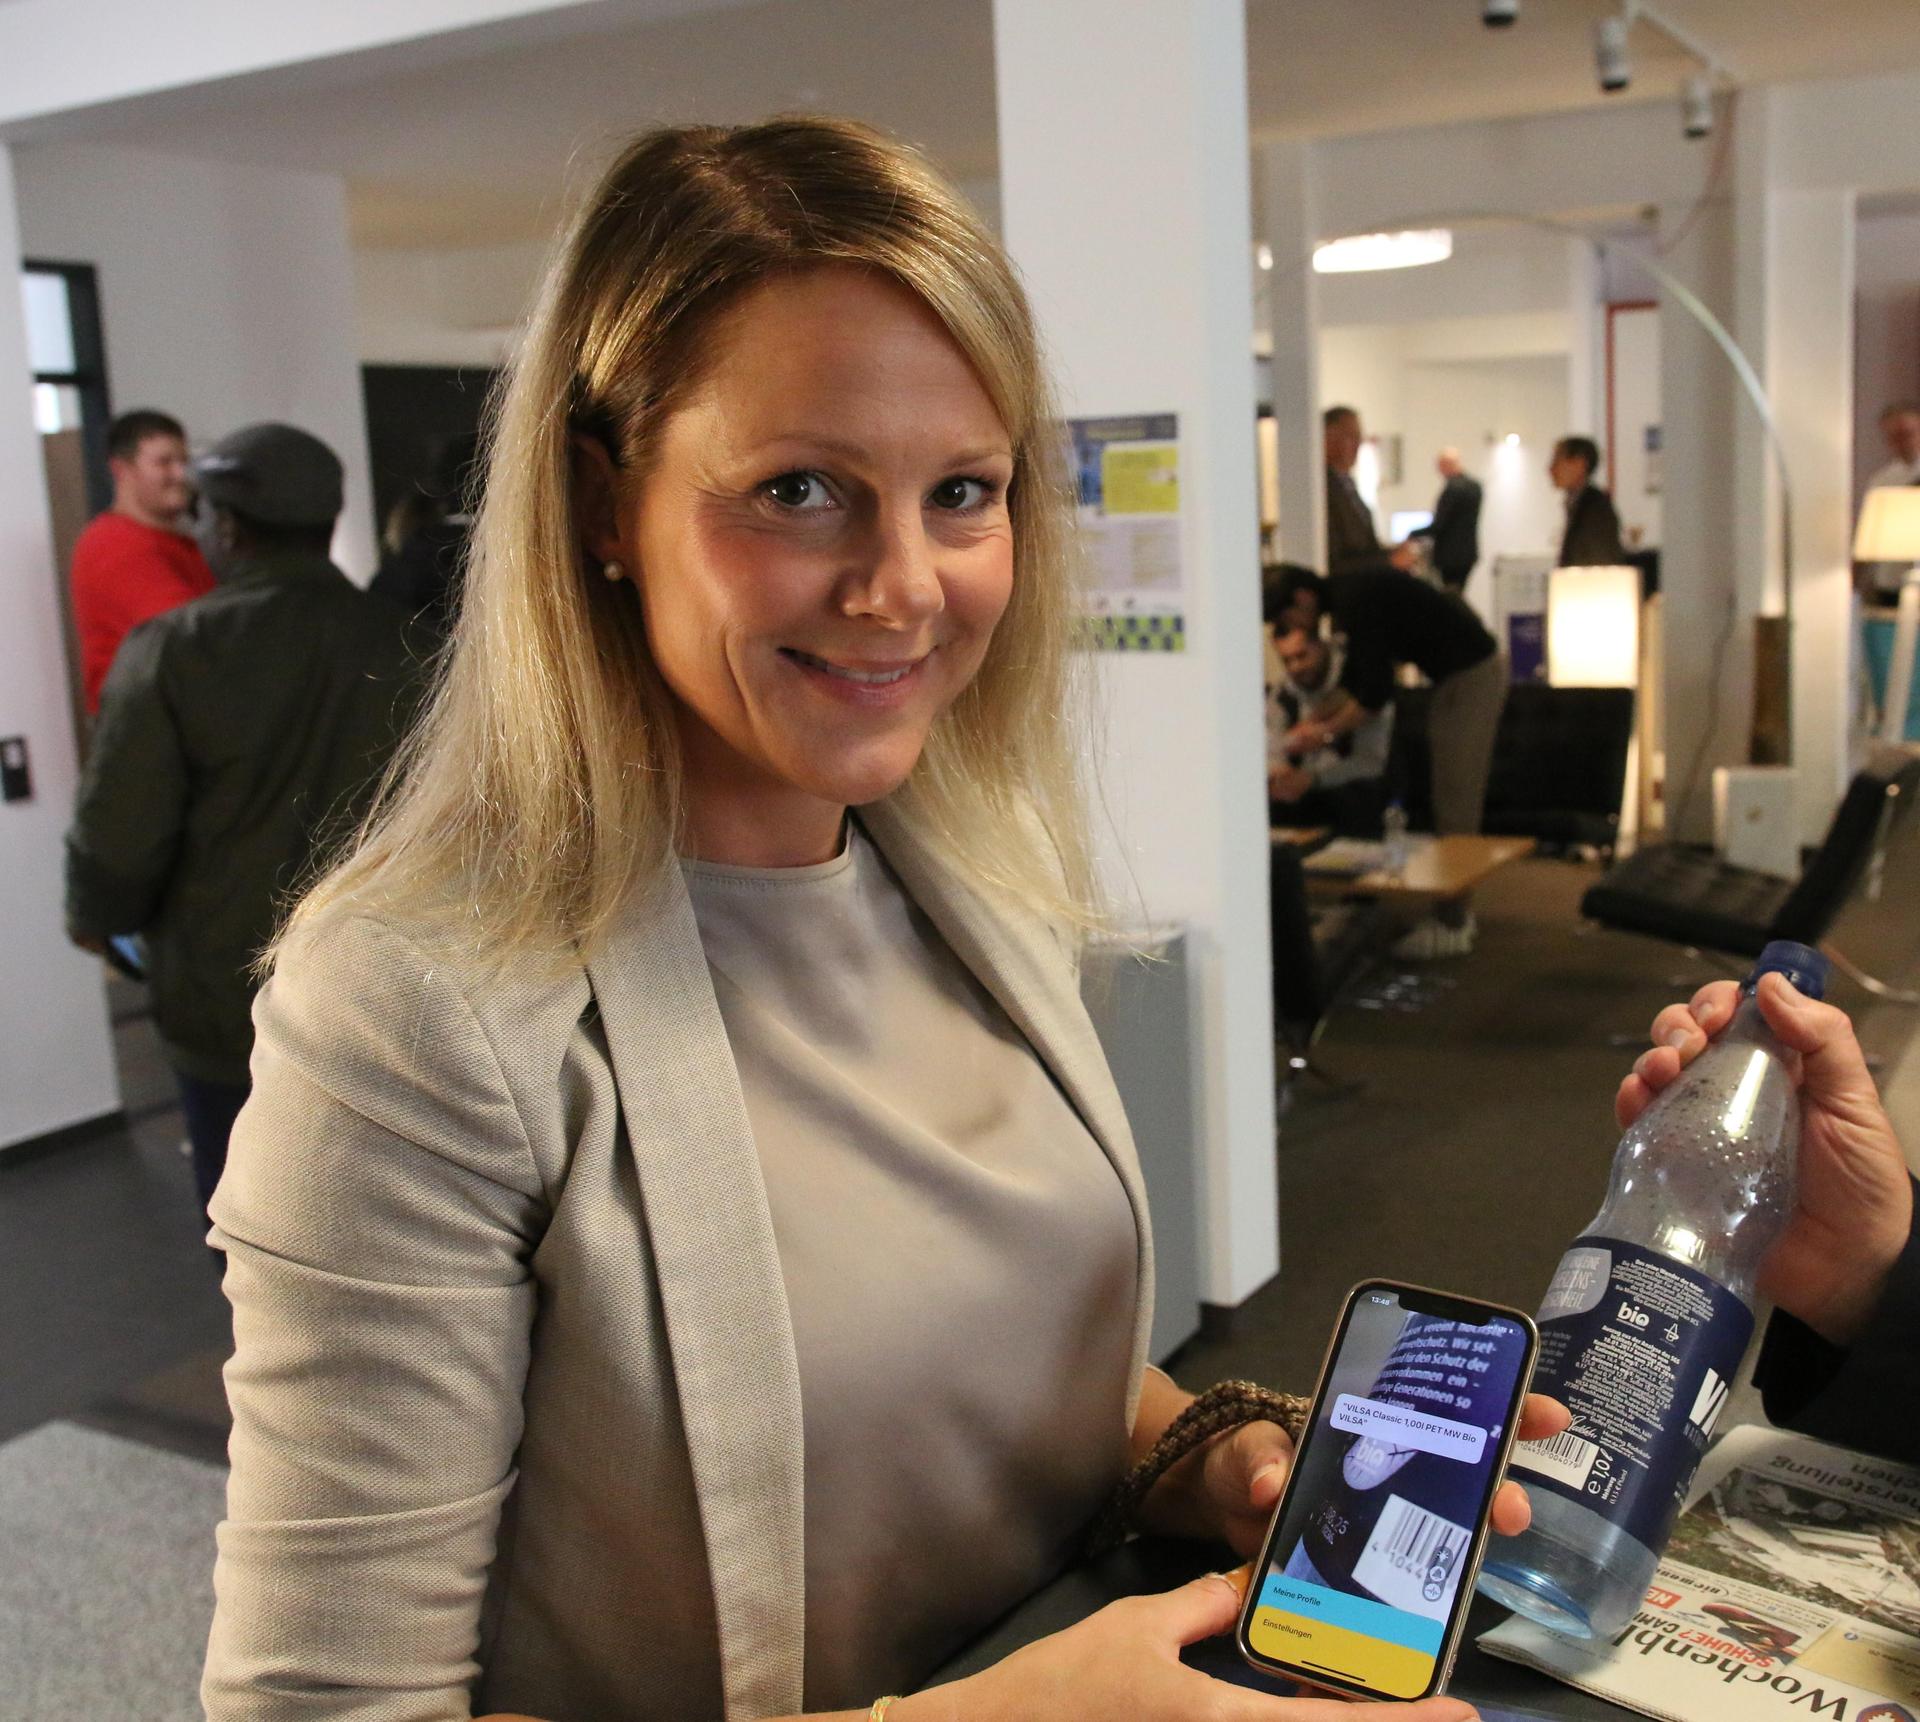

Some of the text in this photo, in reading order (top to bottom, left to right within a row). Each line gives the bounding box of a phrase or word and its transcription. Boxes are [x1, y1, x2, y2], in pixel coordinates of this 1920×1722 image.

[1616, 1301, 1650, 1327] bio
[1452, 1337, 1471, 1349] Wir
[1431, 1352, 1467, 1368] Schutz
[1466, 1357, 1490, 1373] der
[1447, 1374, 1467, 1387] ein
[1455, 1397, 1471, 1409] so
[1373, 1410, 1402, 1424] Classic
[1425, 1424, 1443, 1434] PET
[1443, 1428, 1461, 1439] MW
[1462, 1432, 1476, 1443] Bio
[1273, 1587, 1321, 1606] Meine Profile
[1263, 1619, 1312, 1639] Einstellungen
[1677, 1629, 1775, 1668] SCHUHE?
